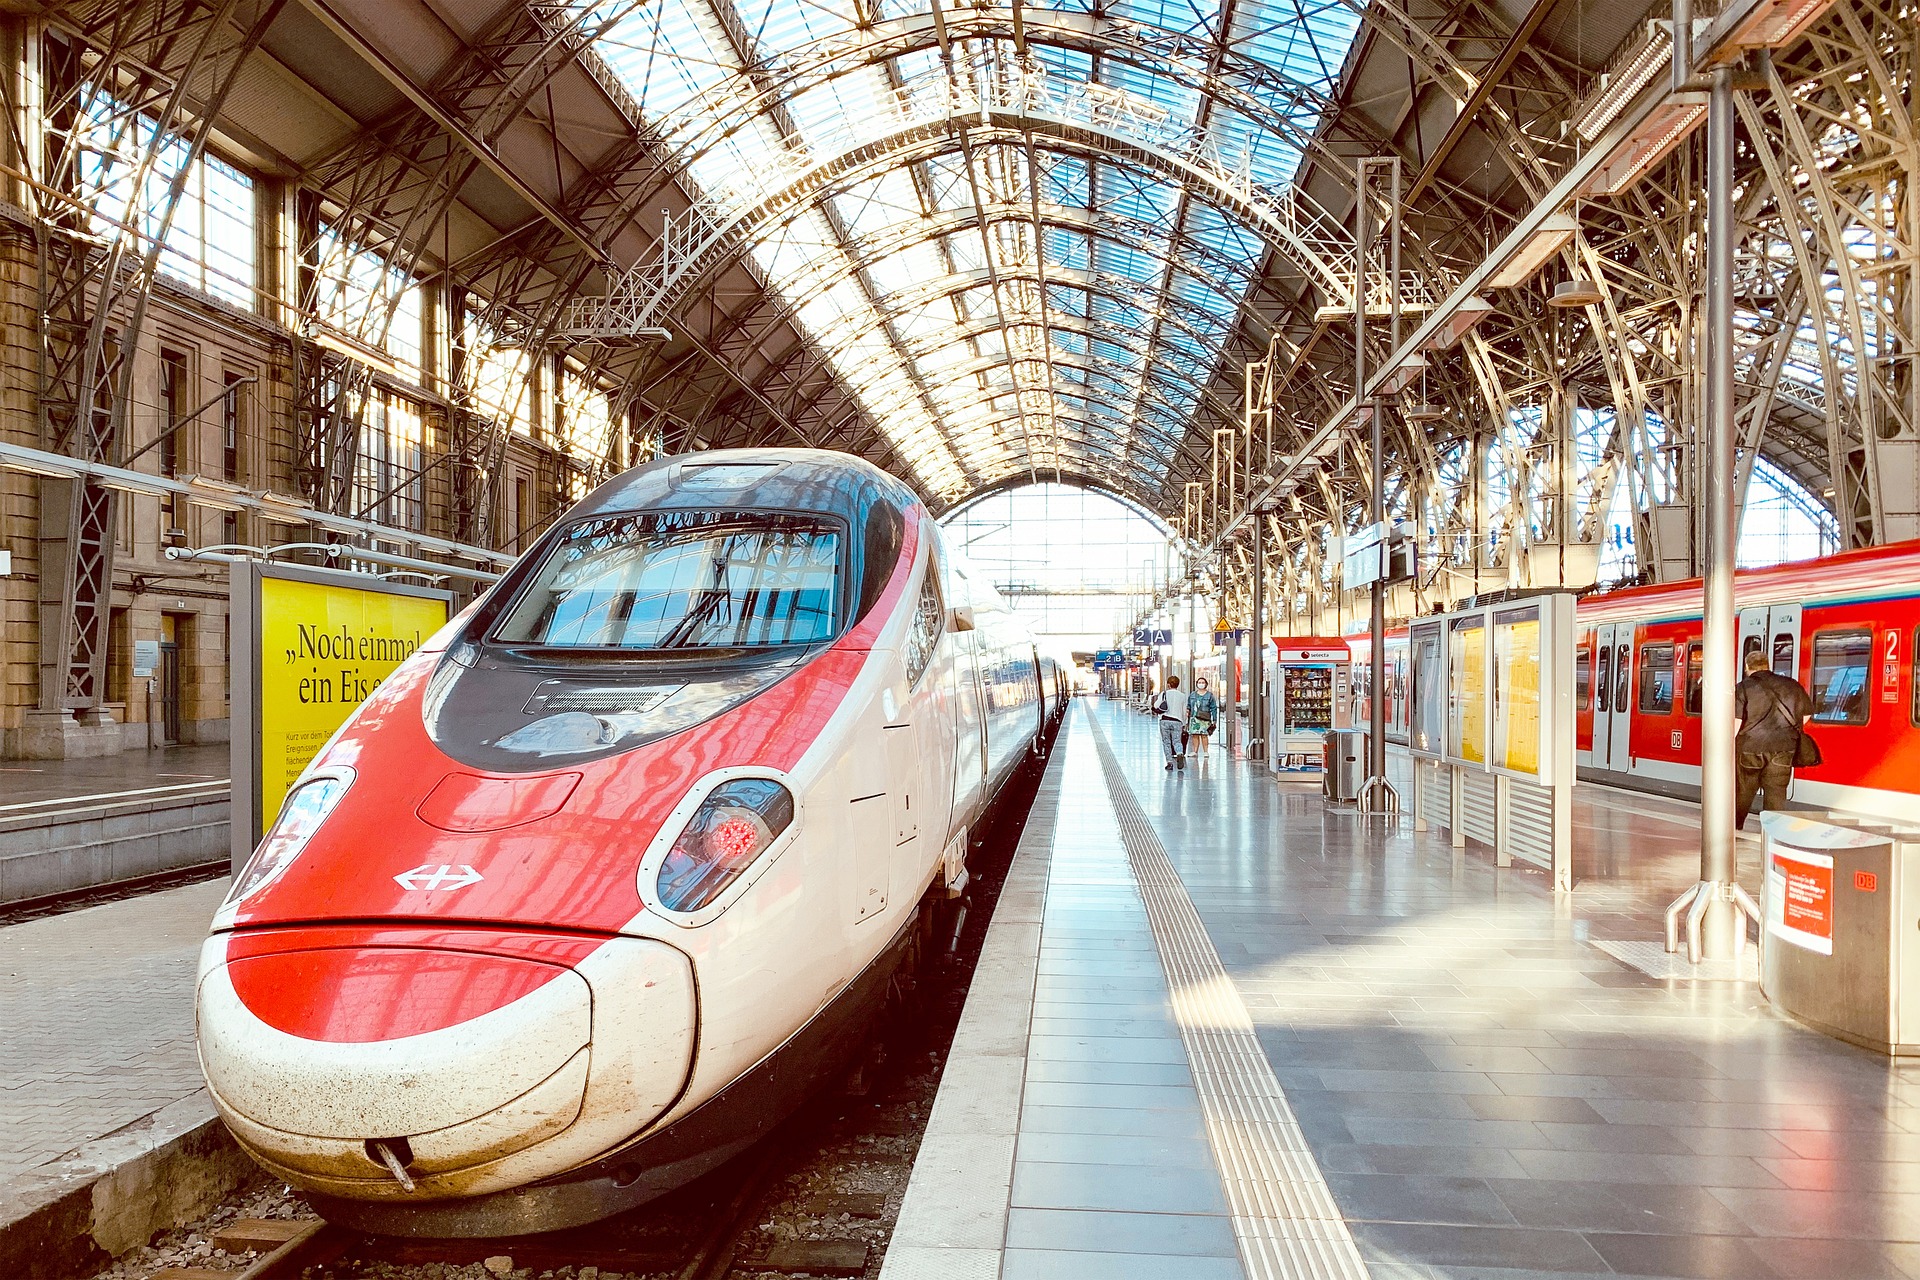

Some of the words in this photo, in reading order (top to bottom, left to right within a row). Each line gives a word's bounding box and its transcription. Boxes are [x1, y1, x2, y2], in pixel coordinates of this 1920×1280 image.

[286, 624, 355, 664] „Noch
[359, 627, 420, 661] einmal
[1135, 630, 1145, 643] 2
[1154, 630, 1166, 643] A
[1886, 631, 1898, 660] 2
[1106, 655, 1112, 663] 2
[1115, 654, 1121, 662] B
[1676, 645, 1684, 666] 2
[299, 667, 333, 703] ein
[340, 668, 368, 703] Eis
[286, 733, 299, 741] Kurz
[310, 731, 323, 740] dem
[324, 730, 335, 739] Tod
[1672, 732, 1682, 748] DB
[1857, 873, 1874, 889] DB
